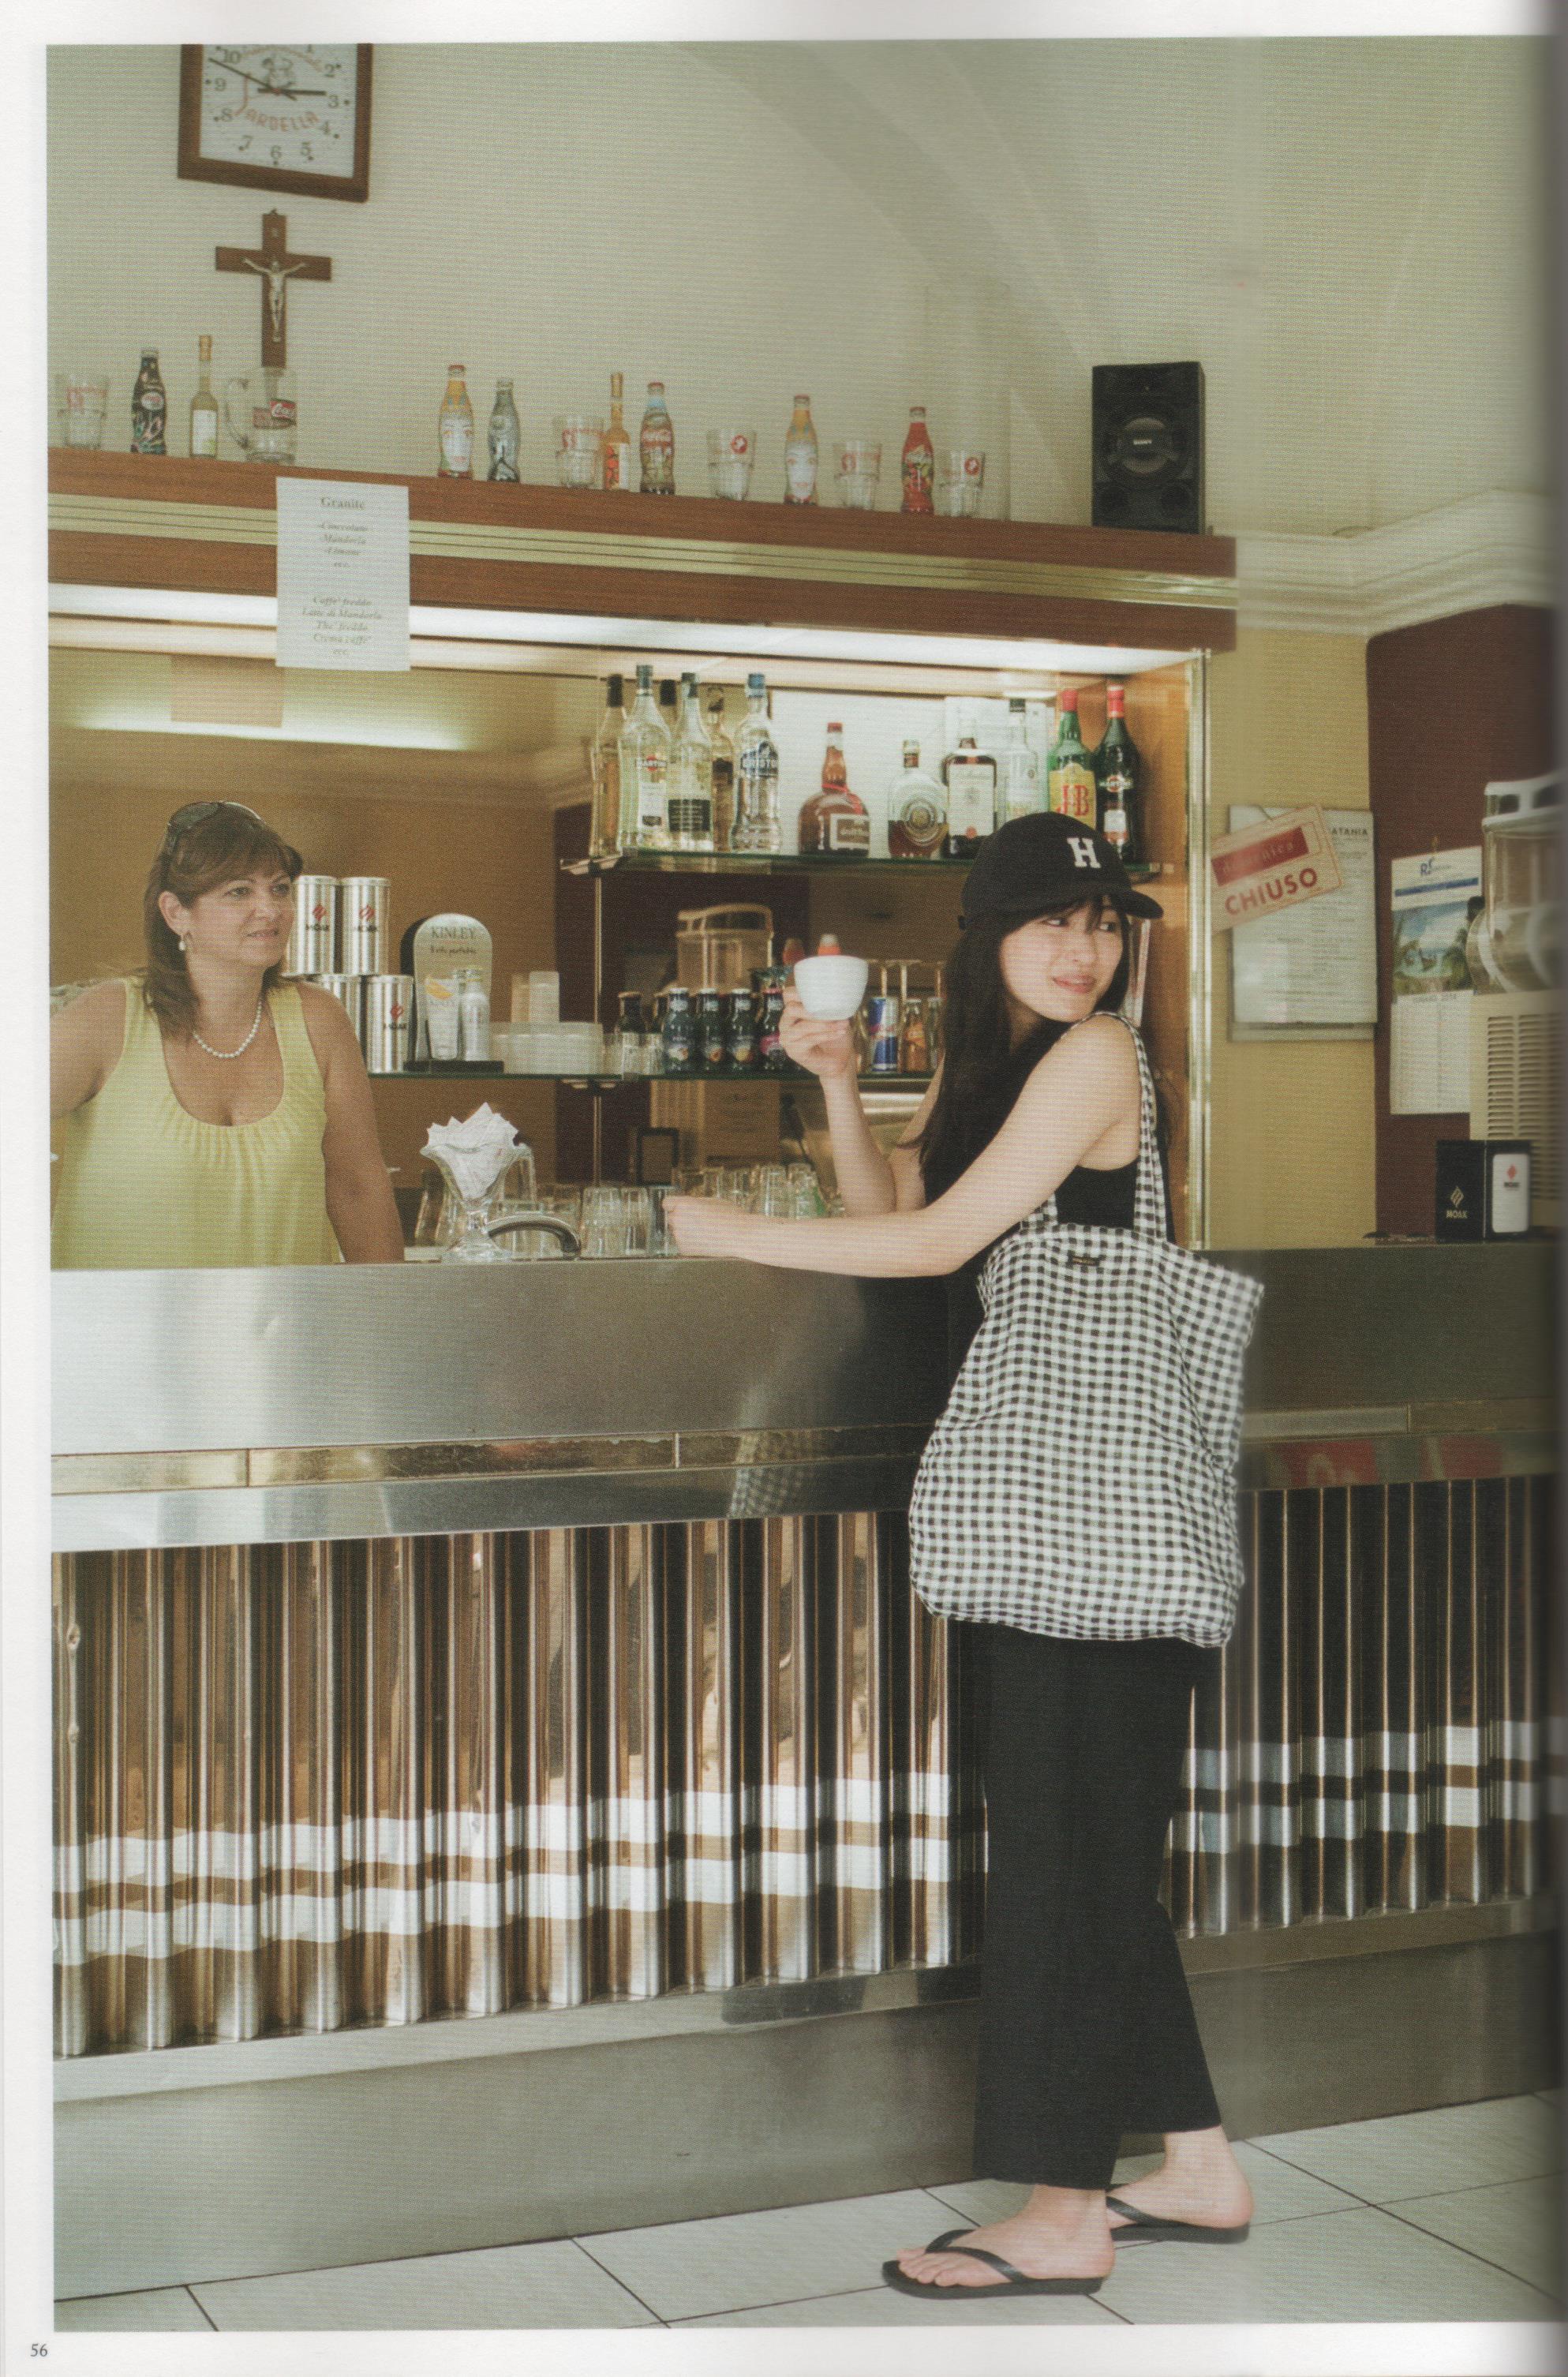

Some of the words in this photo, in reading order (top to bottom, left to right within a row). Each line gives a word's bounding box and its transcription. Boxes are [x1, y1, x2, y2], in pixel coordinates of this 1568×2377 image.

[223, 48, 241, 64] 10
[324, 64, 335, 78] 2
[215, 77, 226, 92] 9
[327, 95, 339, 109] 3
[221, 107, 233, 122] 8
[318, 121, 331, 135] 4
[241, 134, 253, 149] 7
[301, 141, 311, 156] 5
[271, 145, 282, 159] 6
[320, 496, 365, 510] Granite
[1327, 827, 1369, 837] ATANIA
[1067, 837, 1102, 869] H
[1225, 867, 1318, 916] CHIUSO
[431, 926, 477, 940] KINLEY
